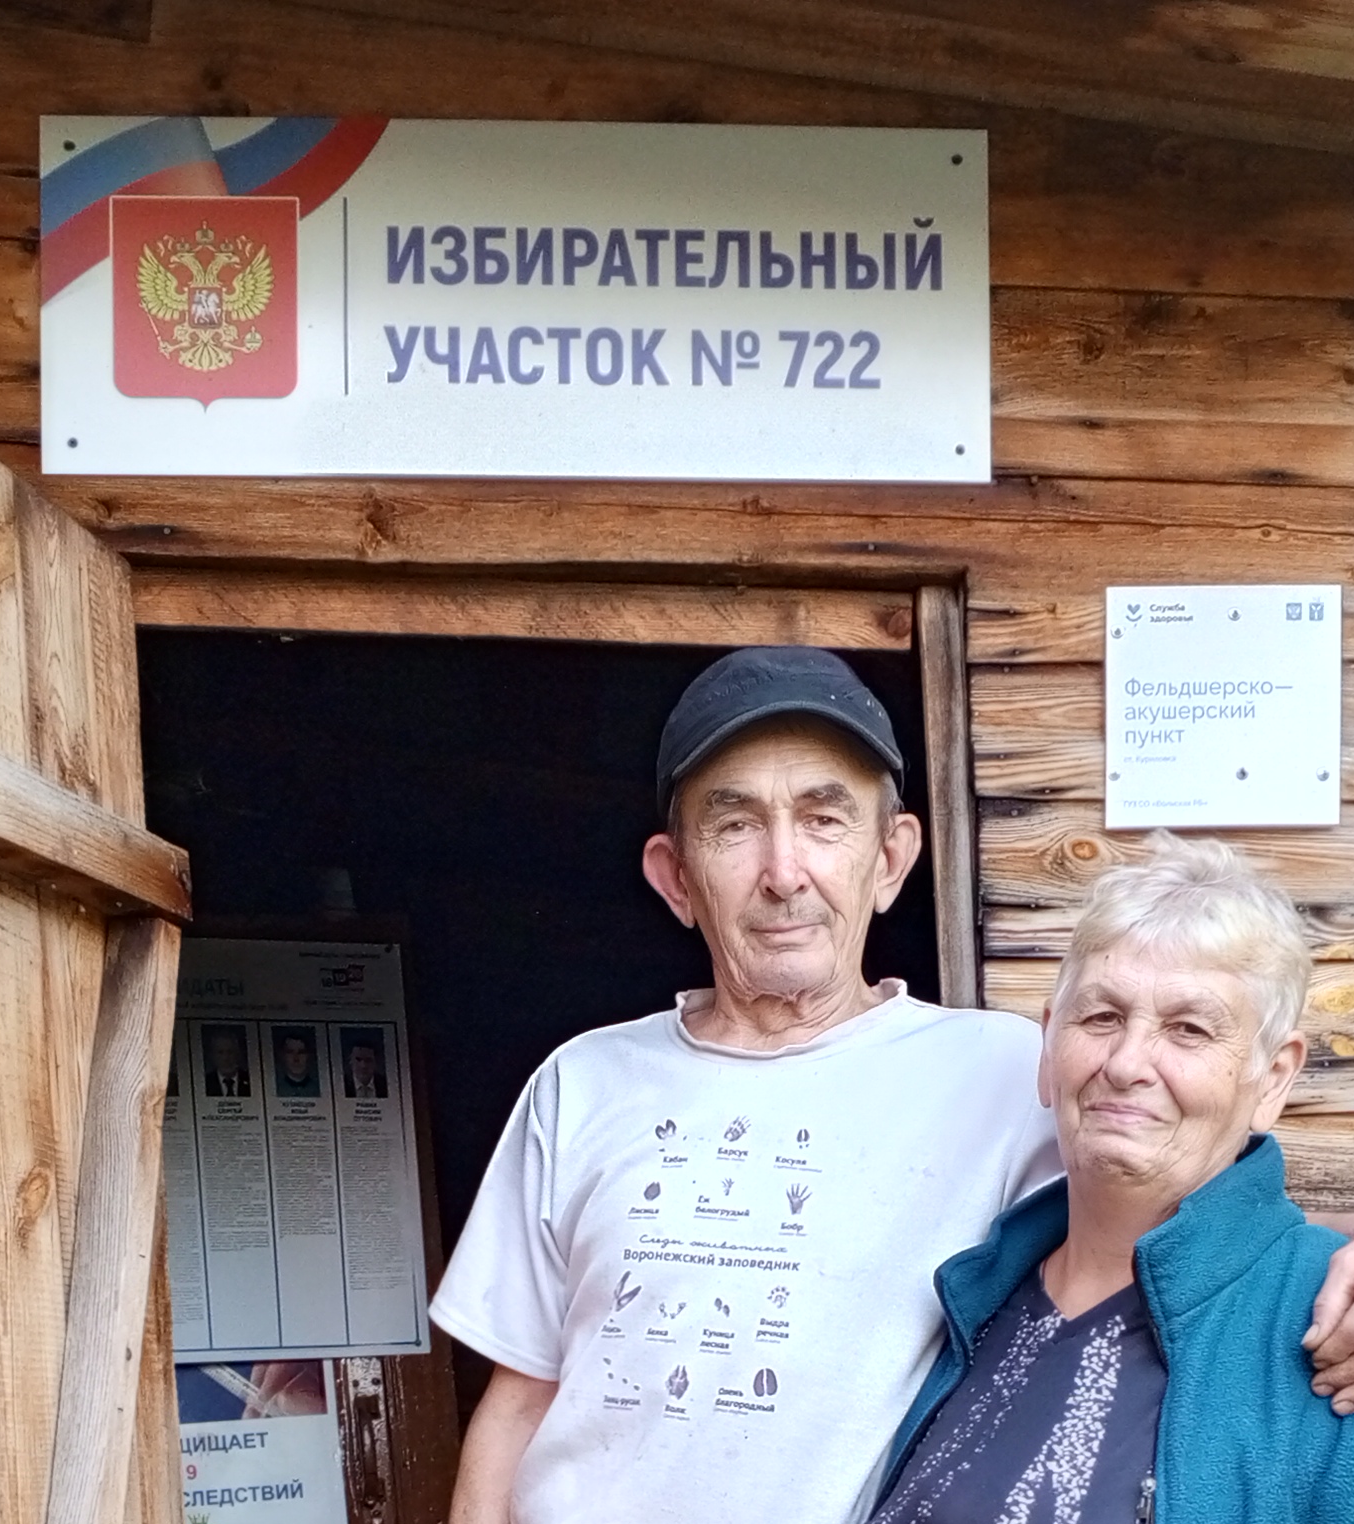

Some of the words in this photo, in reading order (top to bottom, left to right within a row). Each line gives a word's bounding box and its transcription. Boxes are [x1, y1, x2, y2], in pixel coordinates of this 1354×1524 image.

[385, 216, 943, 291] ИЗБИРАТЕЛЬНЫЙ
[384, 325, 668, 387] УЧАСТОК
[692, 330, 760, 387] №
[778, 332, 881, 389] 722
[1149, 603, 1186, 613] Служба
[1149, 614, 1194, 623] здоровья
[1124, 701, 1255, 724] акушерский
[1125, 729, 1185, 748] пункт
[717, 1147, 749, 1159] Барсук
[623, 1248, 715, 1266] Воронежский
[718, 1254, 800, 1272] заповедник
